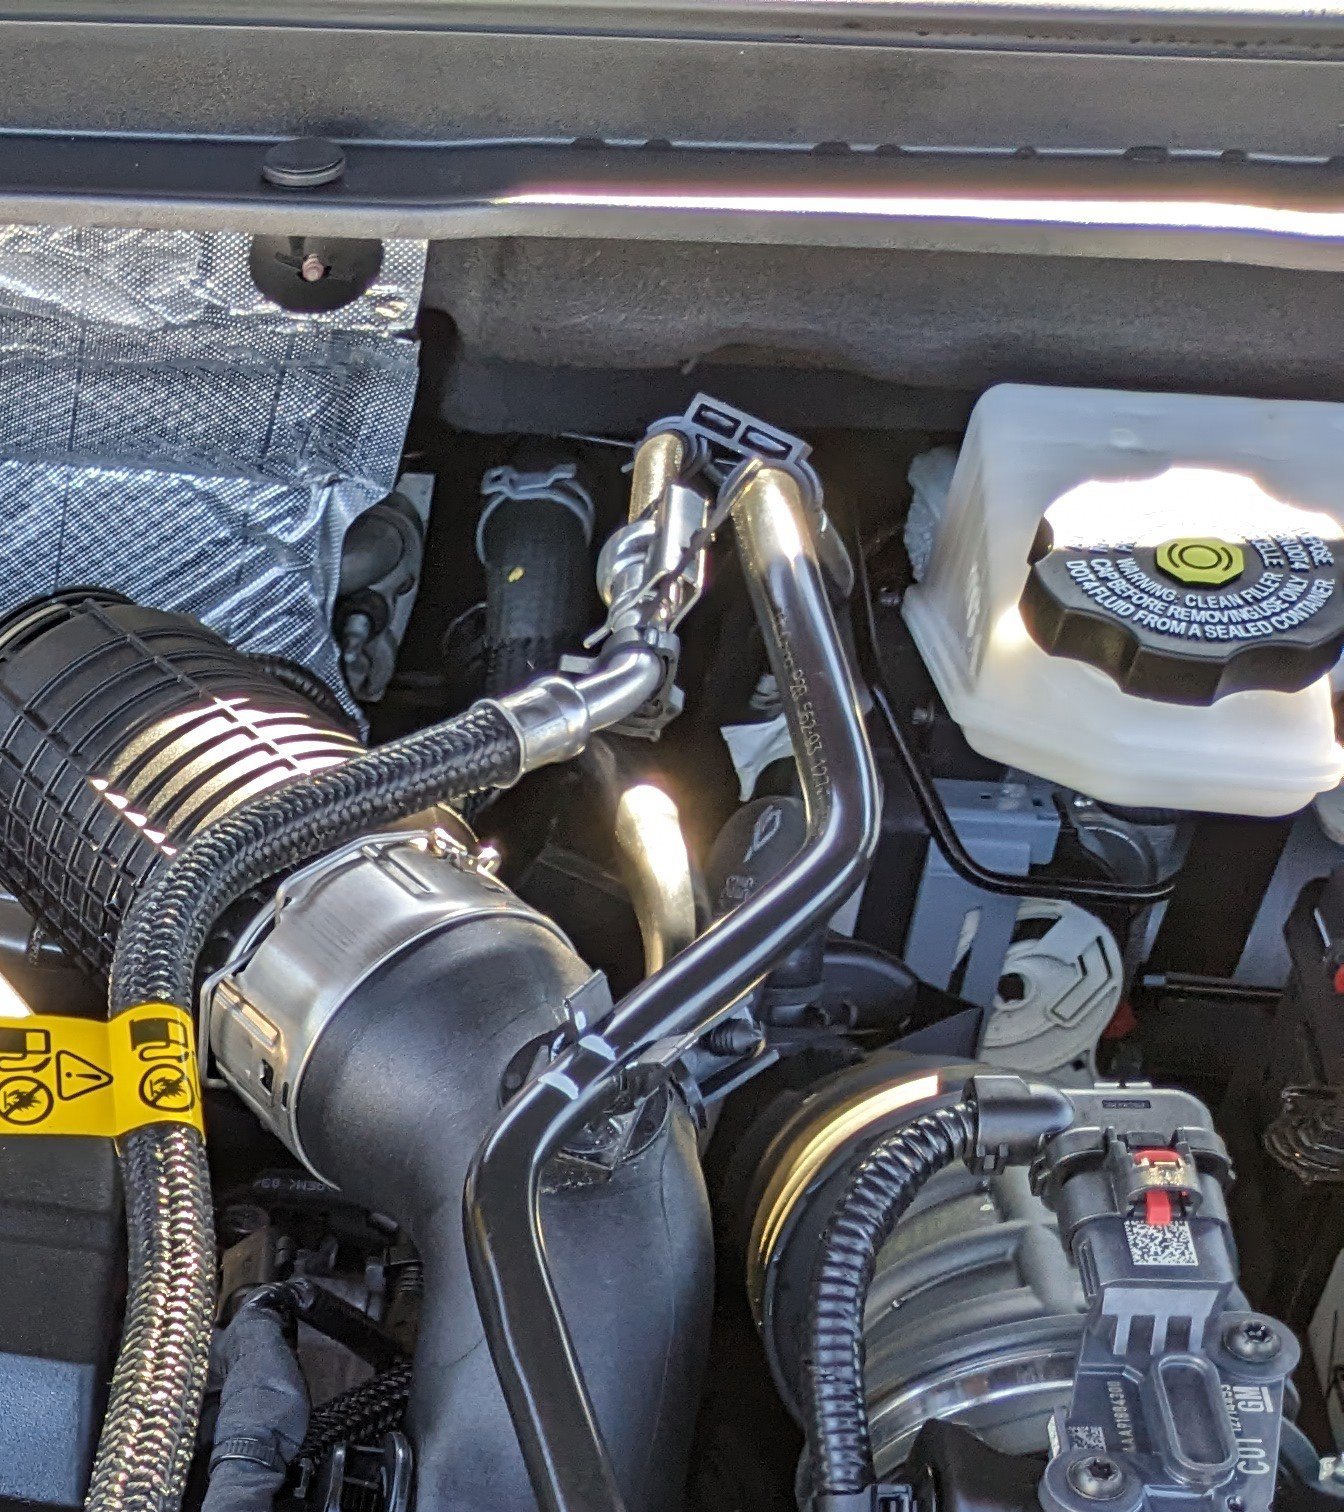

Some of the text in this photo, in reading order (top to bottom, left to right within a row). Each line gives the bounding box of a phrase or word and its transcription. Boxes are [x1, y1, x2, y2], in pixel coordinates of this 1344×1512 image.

[1090, 558, 1119, 585] CAP
[1113, 579, 1171, 614] BEFORE
[1278, 574, 1309, 602] ONLY
[1185, 593, 1244, 610] CLEAN
[1240, 571, 1285, 603] FILLER
[1091, 584, 1135, 618] FLUID
[1133, 610, 1186, 637] FROM
[1187, 623, 1203, 638] A
[1204, 619, 1274, 640] SEALED
[1232, 1385, 1269, 1413] GM
